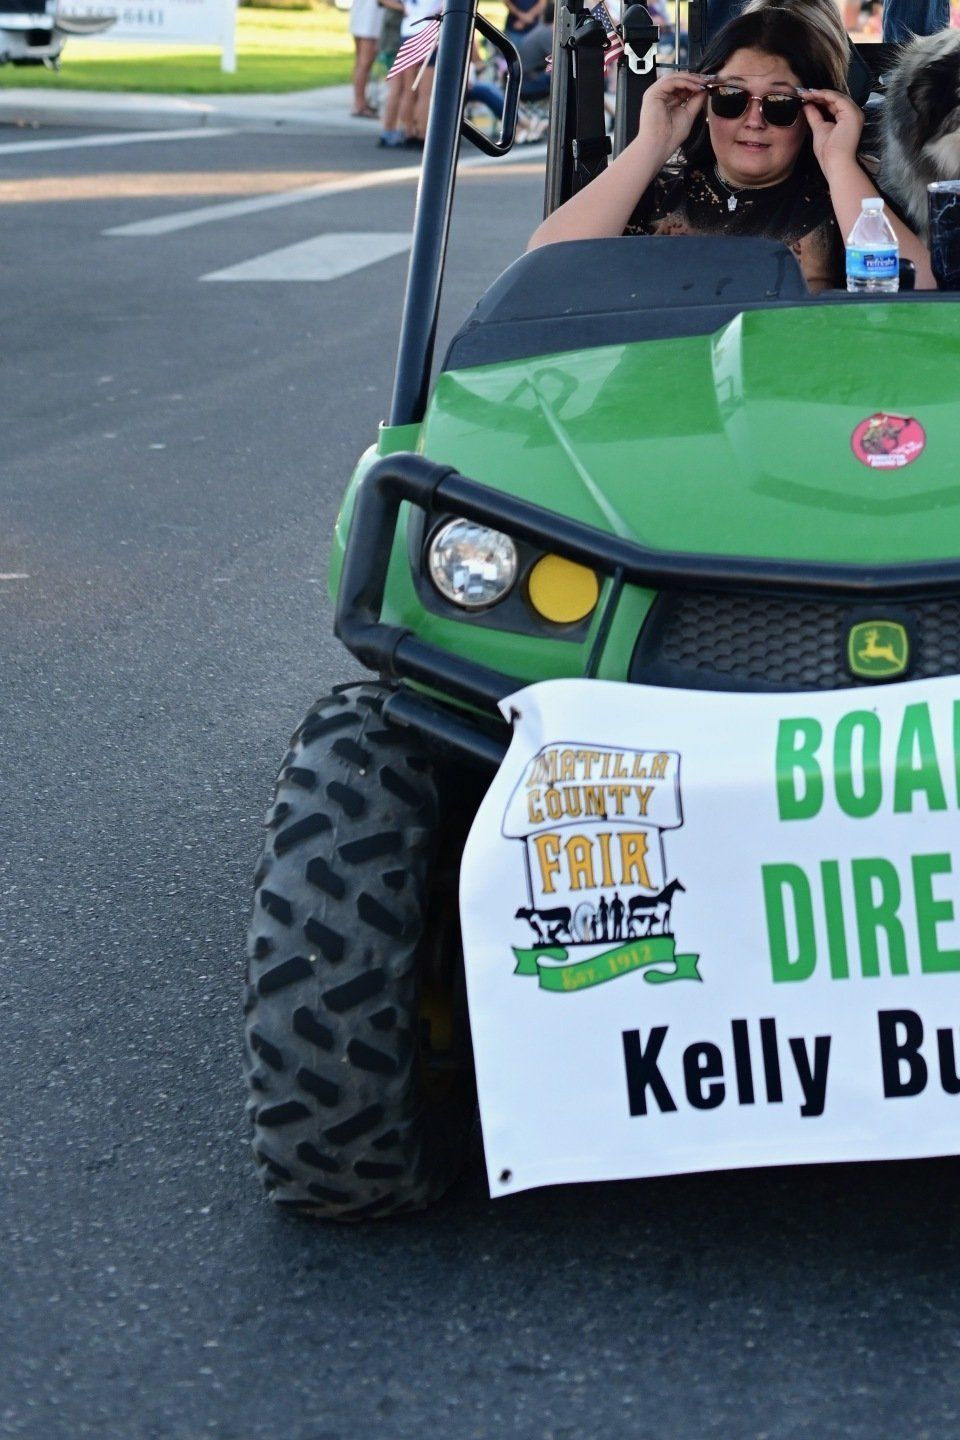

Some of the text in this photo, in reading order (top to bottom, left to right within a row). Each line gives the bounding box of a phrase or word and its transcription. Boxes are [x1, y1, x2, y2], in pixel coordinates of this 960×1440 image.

[526, 748, 671, 788] MATILLA
[527, 783, 655, 825] COUNTY
[534, 831, 660, 894] FAIR
[608, 943, 653, 975] 1912
[621, 1016, 832, 1118] Kelly
